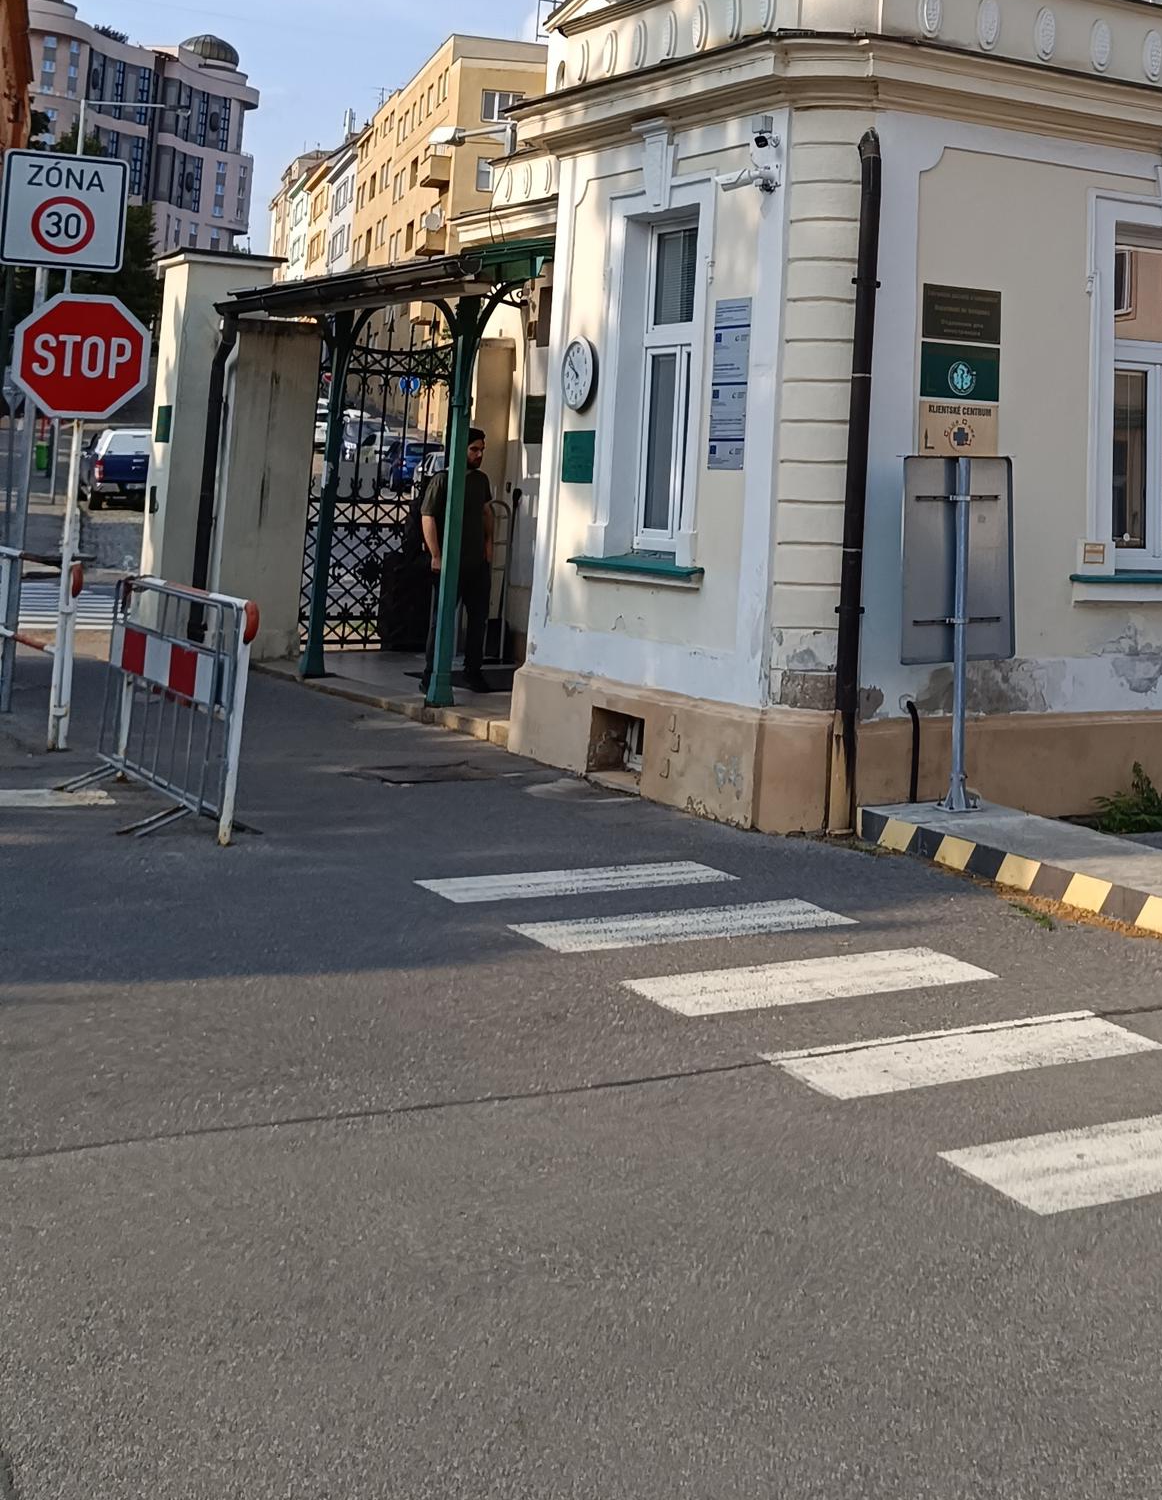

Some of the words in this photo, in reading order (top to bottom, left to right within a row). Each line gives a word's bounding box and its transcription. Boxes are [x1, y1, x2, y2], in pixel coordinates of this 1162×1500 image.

[27, 161, 105, 193] ZÓNA
[45, 211, 82, 240] 30
[31, 333, 132, 380] STOP
[928, 404, 961, 415] KLIENTSKÉ
[962, 406, 992, 417] CENTRUM
